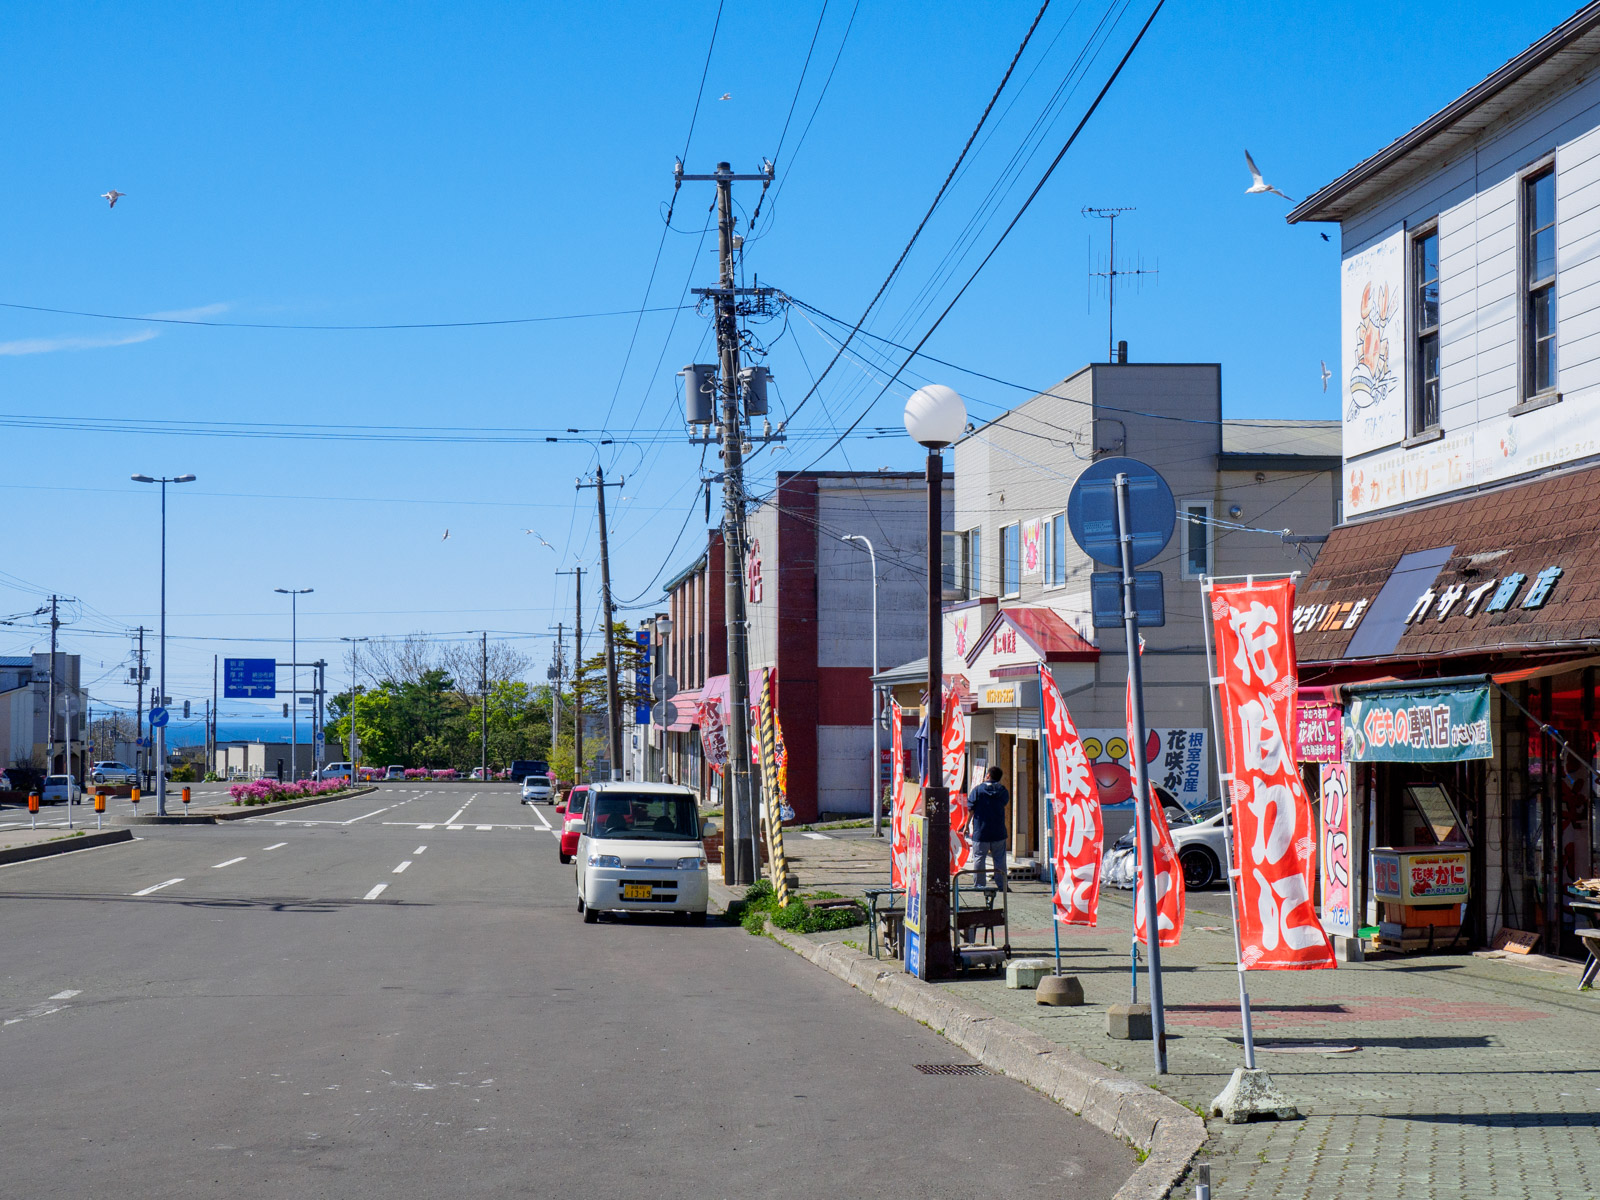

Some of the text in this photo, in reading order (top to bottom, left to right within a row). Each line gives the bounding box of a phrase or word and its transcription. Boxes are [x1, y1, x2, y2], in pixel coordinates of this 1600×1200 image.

[1404, 565, 1564, 625] カサイ商店
[1363, 703, 1450, 748] くだもの専門店
[1163, 729, 1187, 797] 花咲が
[1183, 732, 1204, 792] 根室名産
[1323, 767, 1348, 888] かに
[1375, 858, 1400, 892] かに
[1411, 864, 1466, 886] 花咲かに
[1331, 906, 1350, 926] かさい
